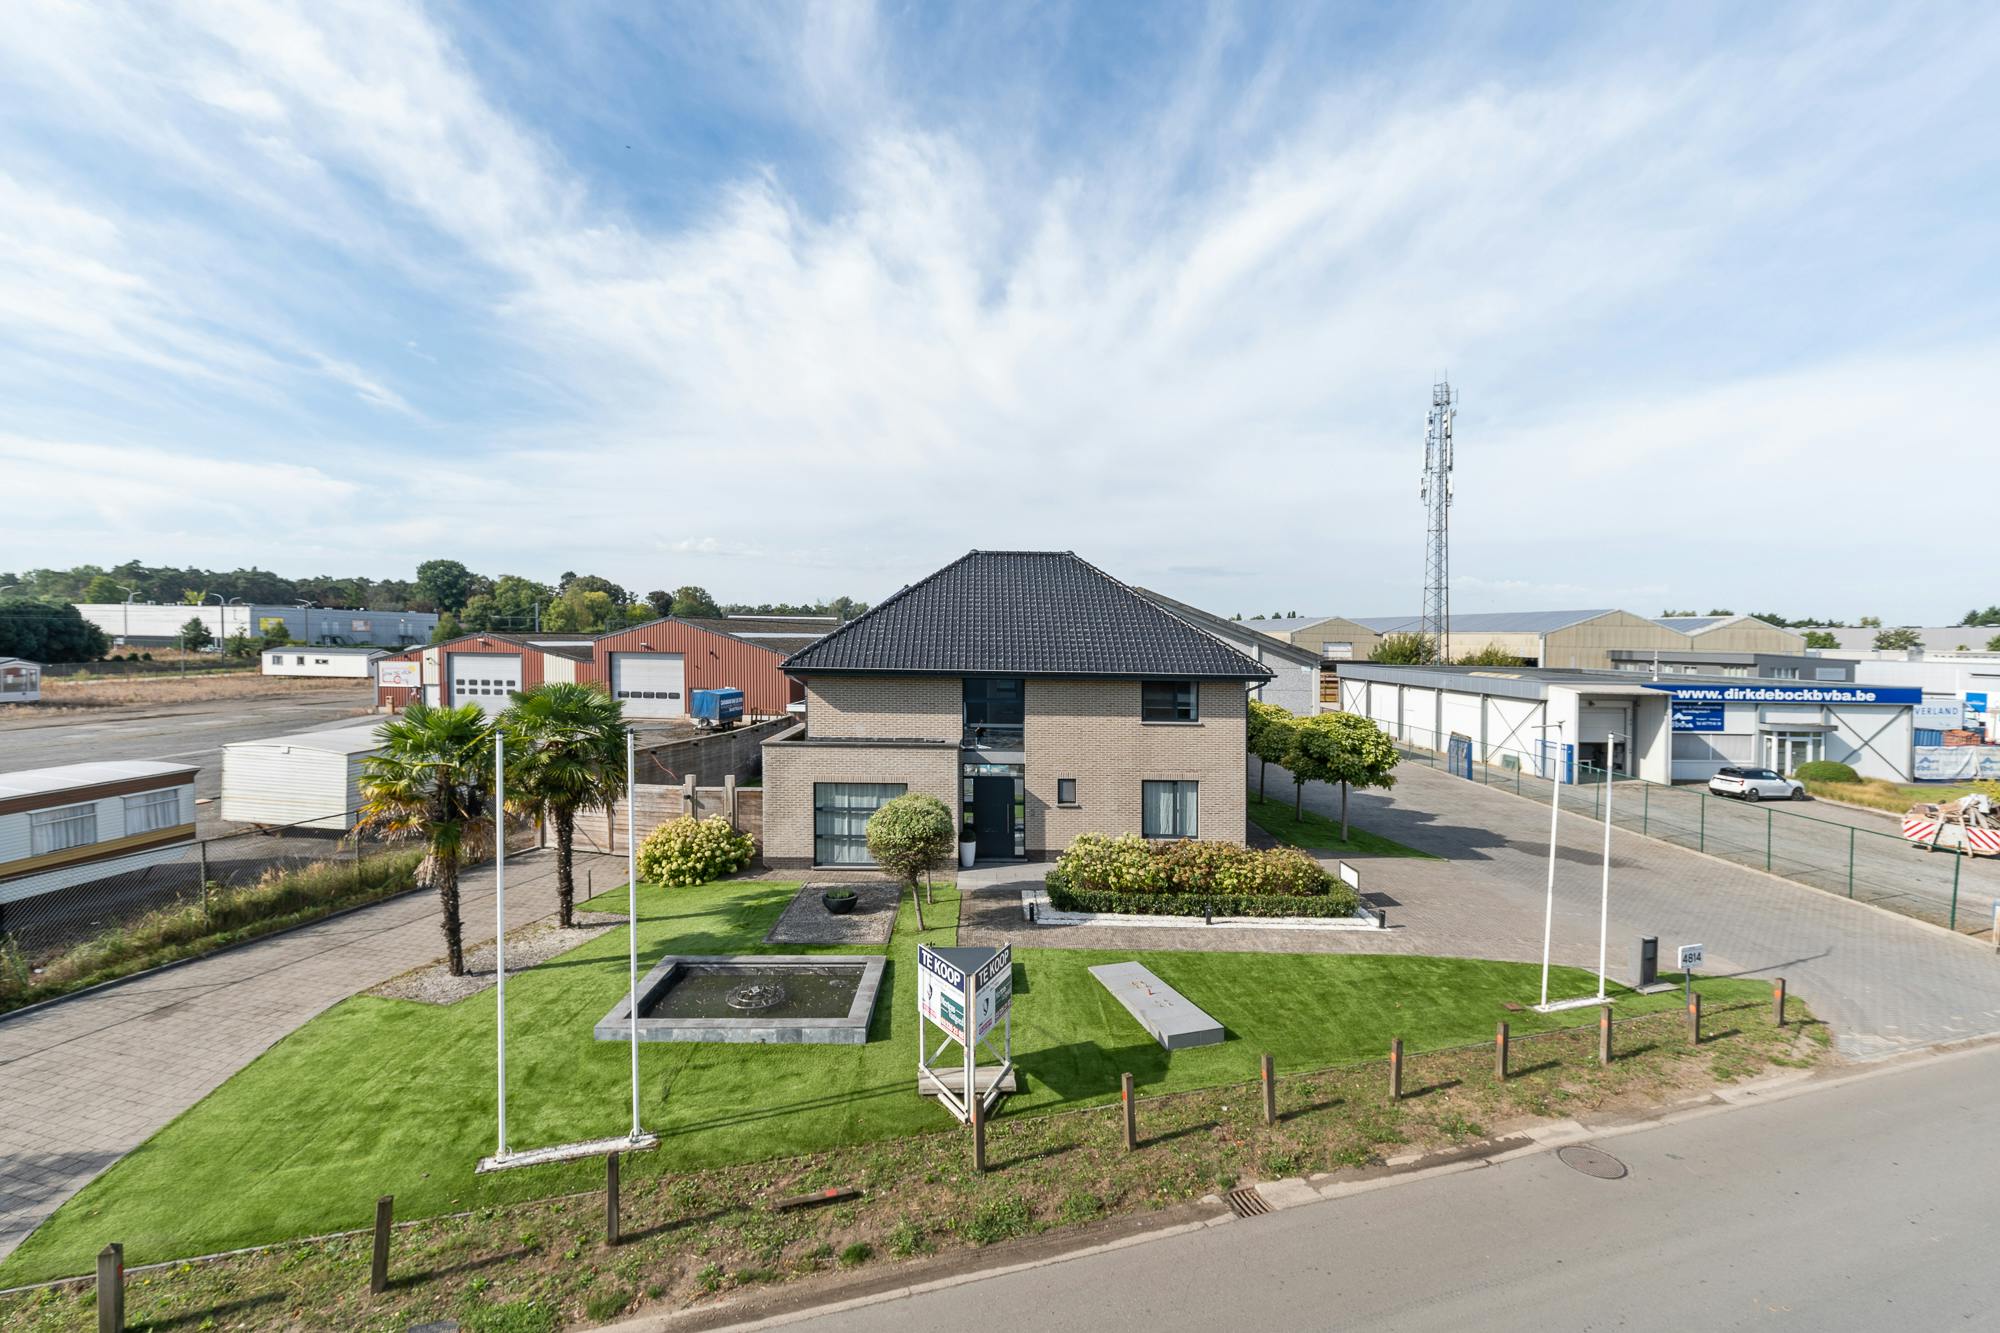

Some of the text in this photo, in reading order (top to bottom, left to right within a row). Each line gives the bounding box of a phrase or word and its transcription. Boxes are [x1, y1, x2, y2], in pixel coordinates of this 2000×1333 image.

[1677, 688, 1876, 702] www.dirkdebockbvba.be
[921, 949, 961, 986] TE KOOP
[979, 950, 1009, 986] TE KOOP
[1682, 952, 1701, 962] 4814
